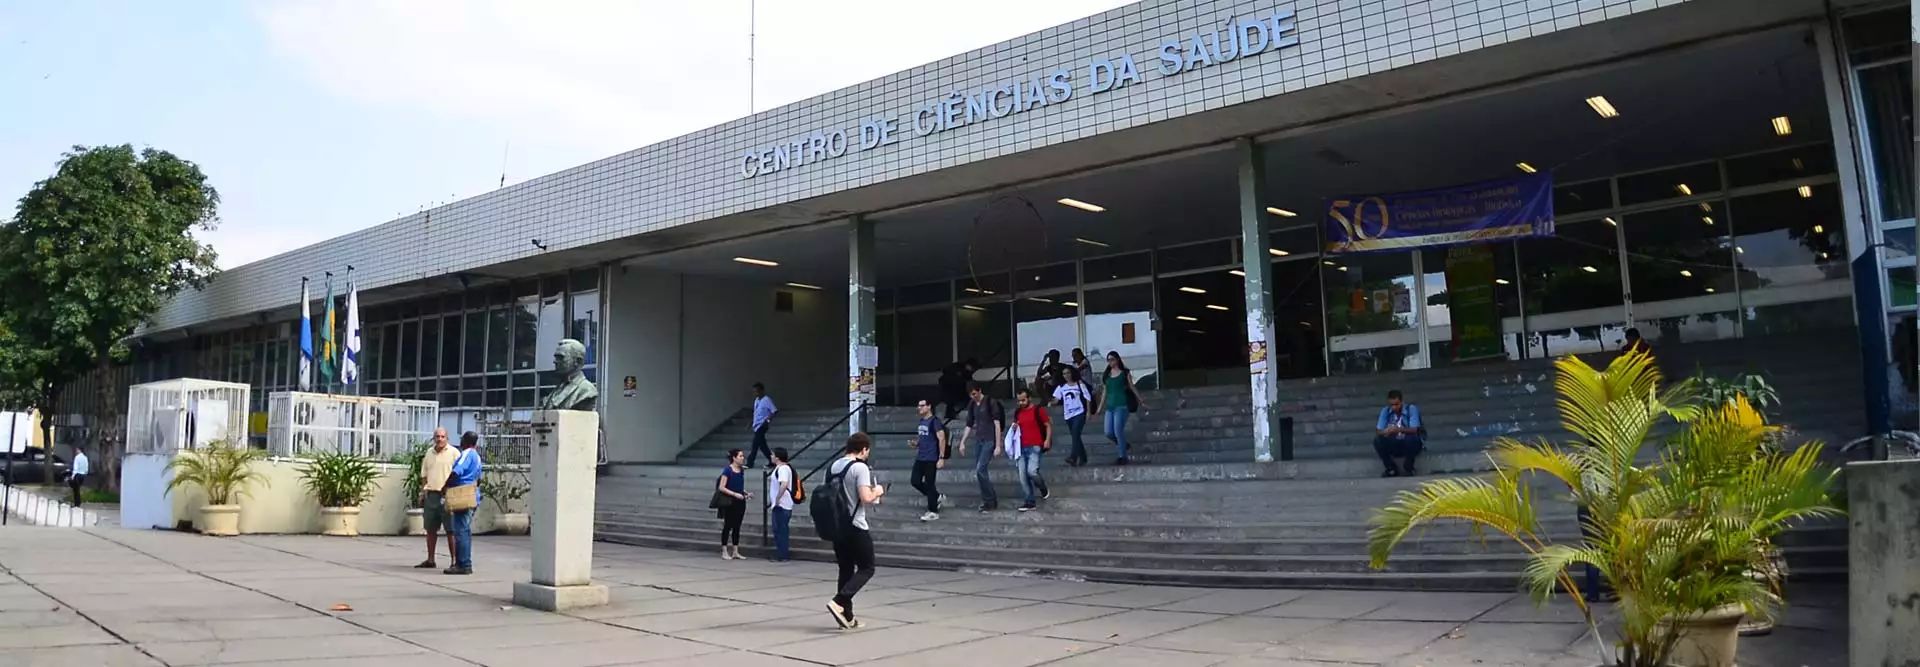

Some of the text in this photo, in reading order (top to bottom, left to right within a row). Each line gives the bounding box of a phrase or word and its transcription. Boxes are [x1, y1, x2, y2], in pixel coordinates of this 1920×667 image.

[741, 9, 1299, 179] CENTRO DE CIÊNCIAS DA SAÚDE
[1328, 197, 1389, 248] 50
